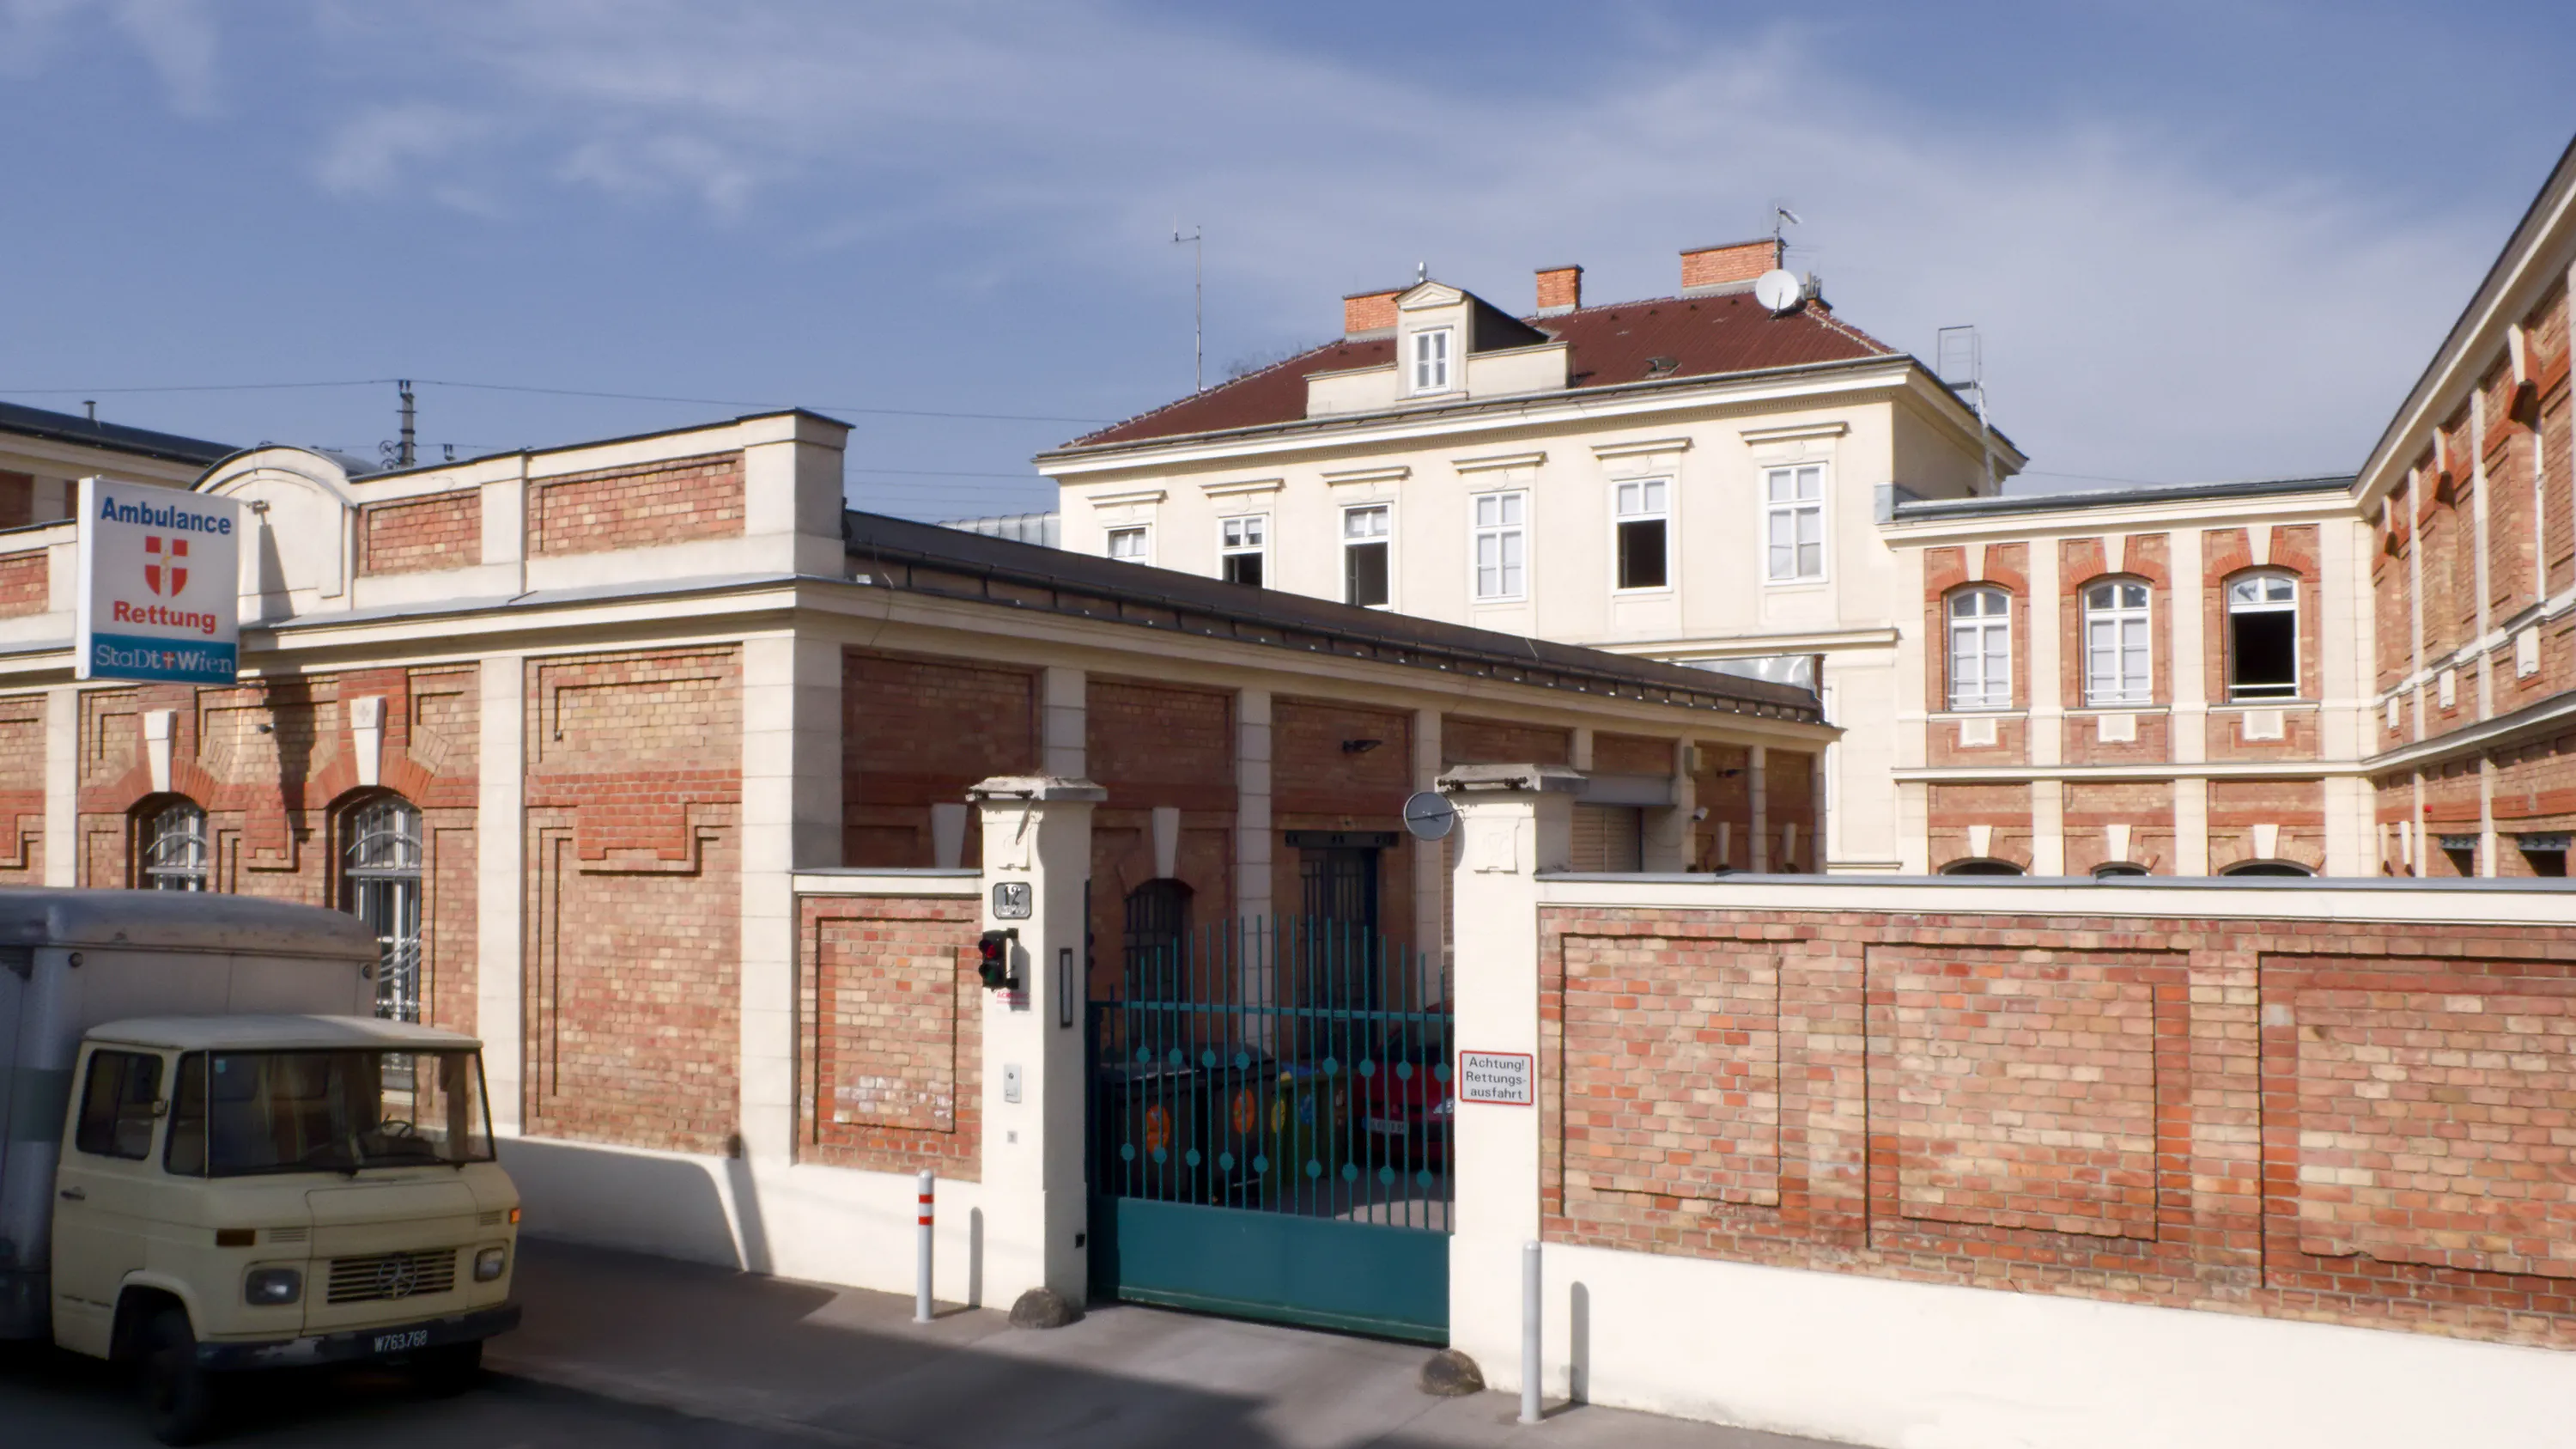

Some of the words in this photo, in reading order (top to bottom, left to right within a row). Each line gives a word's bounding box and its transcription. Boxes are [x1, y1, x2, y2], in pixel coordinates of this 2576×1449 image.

[100, 496, 232, 535] Ambulance
[112, 600, 216, 635] Rettung
[174, 650, 234, 674] Wien
[1004, 885, 1021, 906] 12
[1469, 1056, 1525, 1072] Achtung!
[1466, 1071, 1527, 1087] Rettungs-
[1470, 1087, 1522, 1099] ausfahrt
